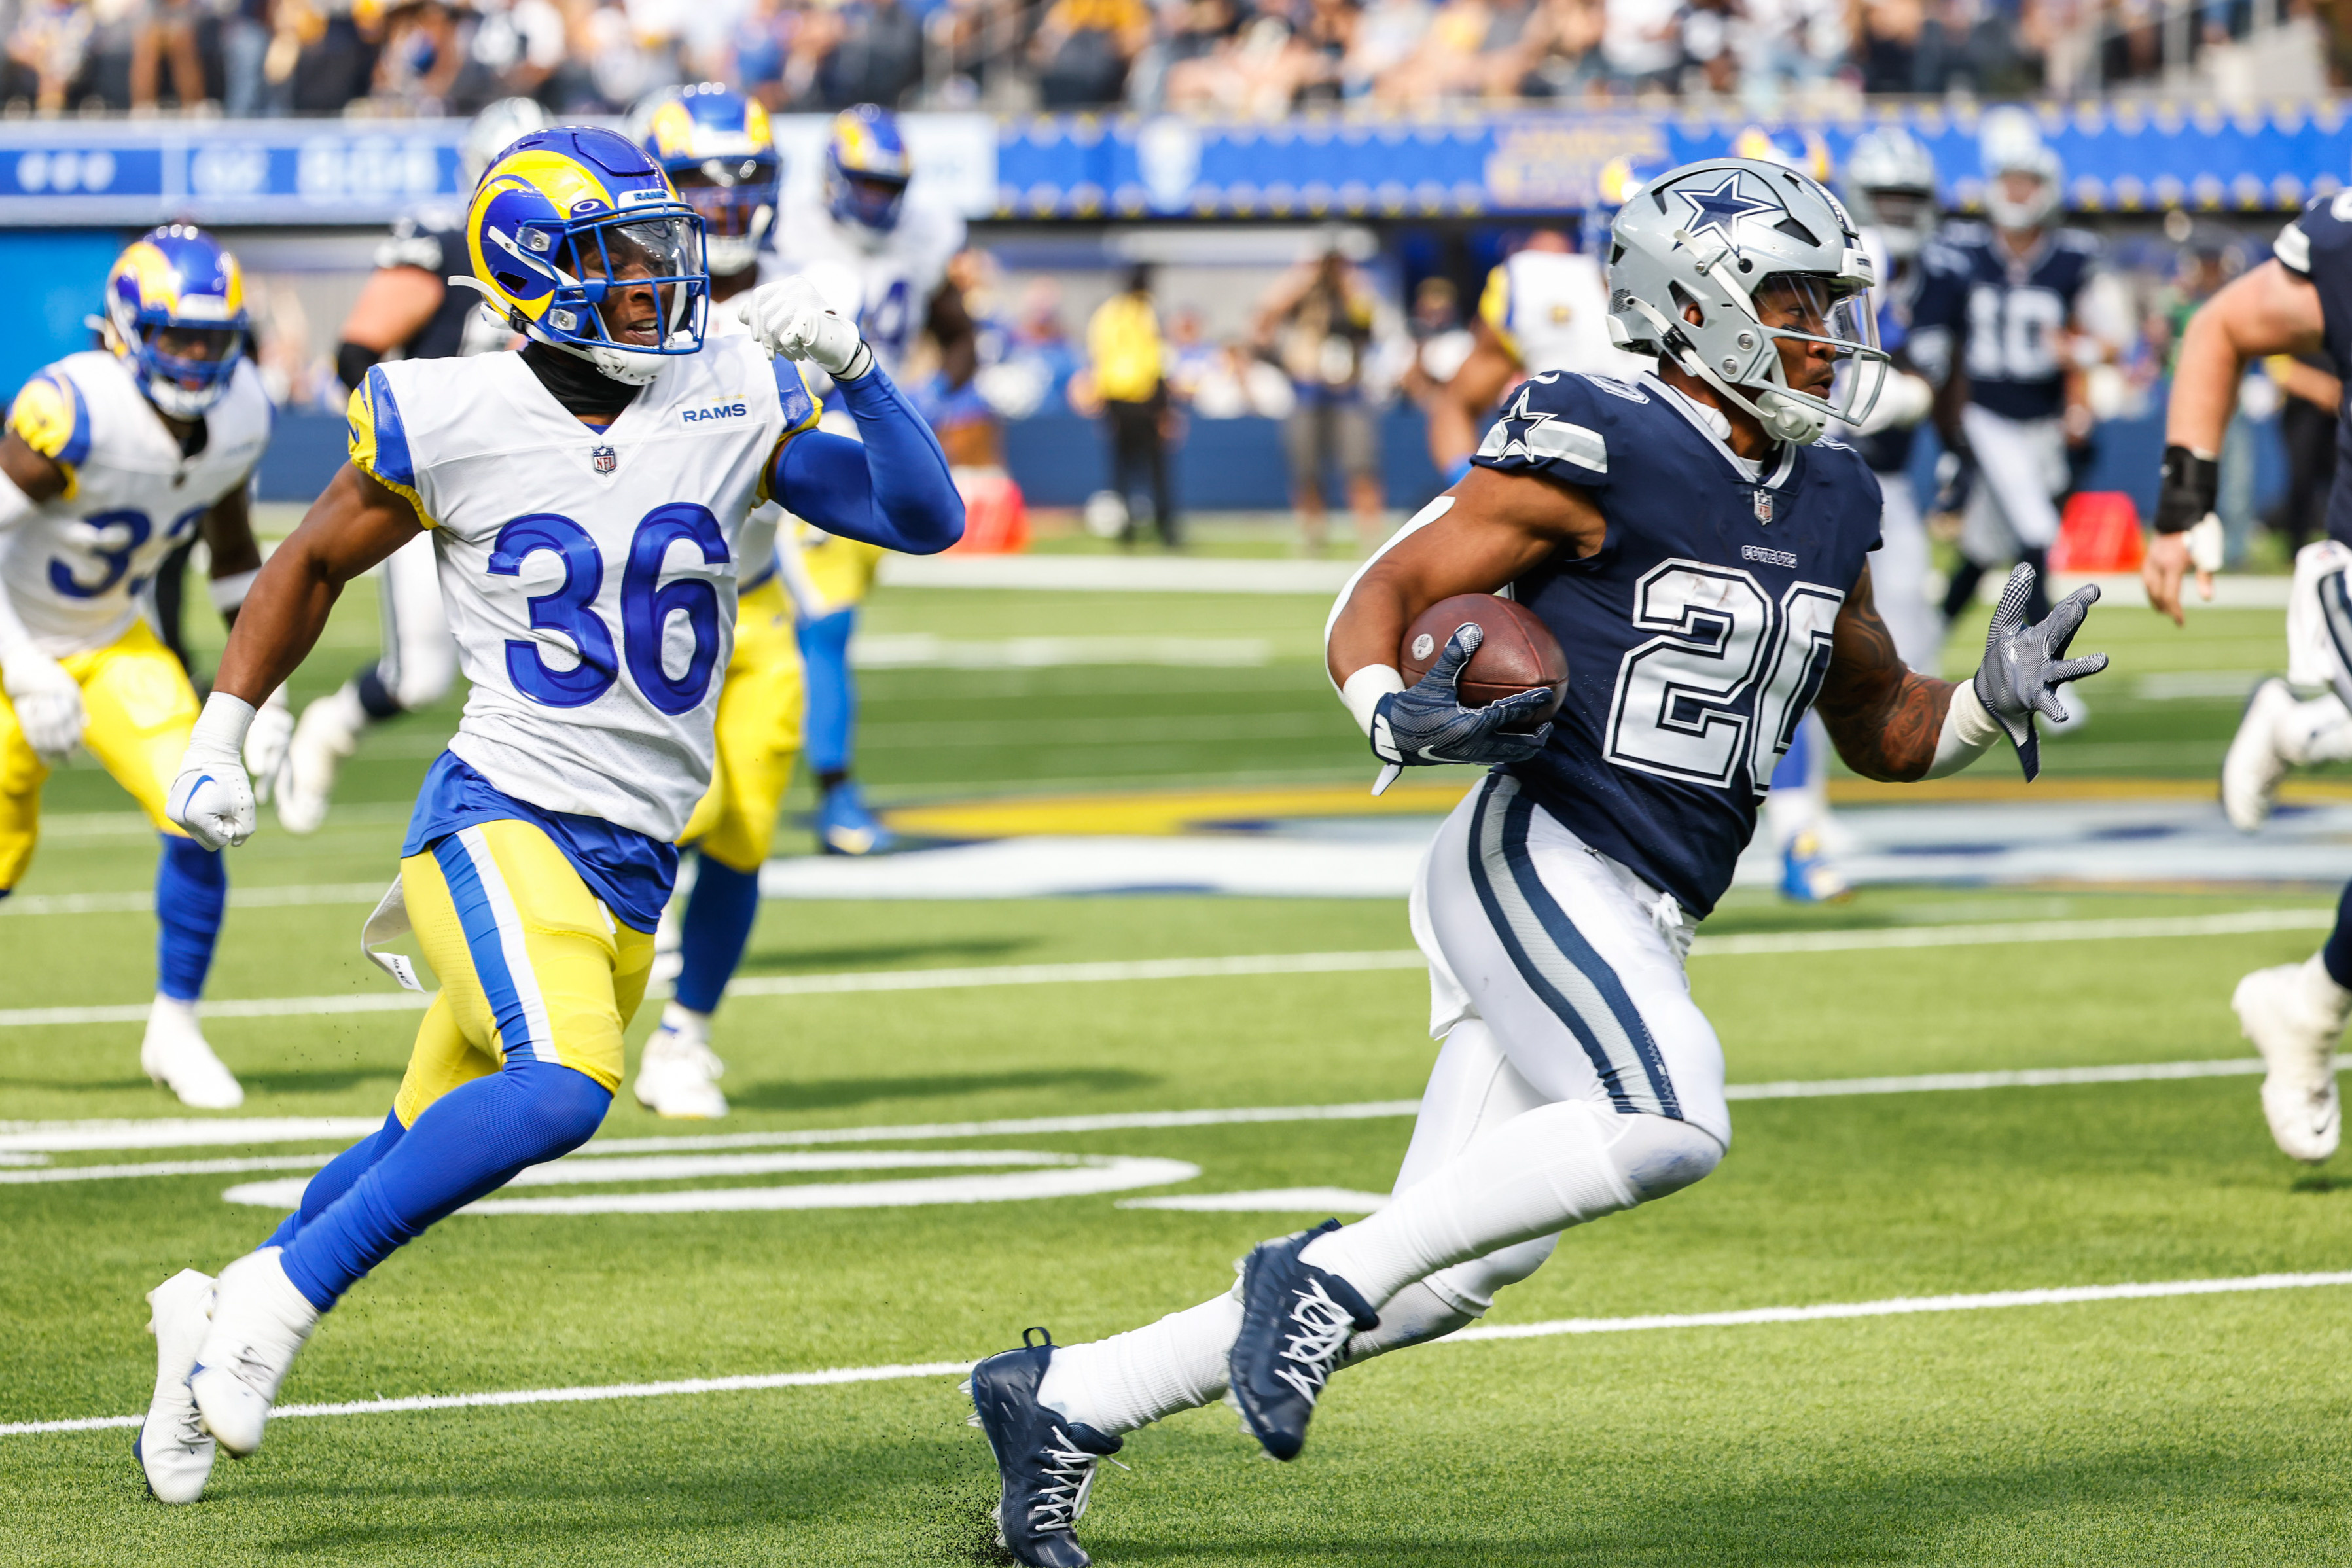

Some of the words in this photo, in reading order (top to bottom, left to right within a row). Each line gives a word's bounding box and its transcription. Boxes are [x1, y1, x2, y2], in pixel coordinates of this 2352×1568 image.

[633, 190, 668, 202] RAMS
[682, 403, 747, 423] RAMS
[596, 457, 615, 471] NFL
[1741, 544, 1798, 569] COWBOYS
[487, 501, 730, 716] 36
